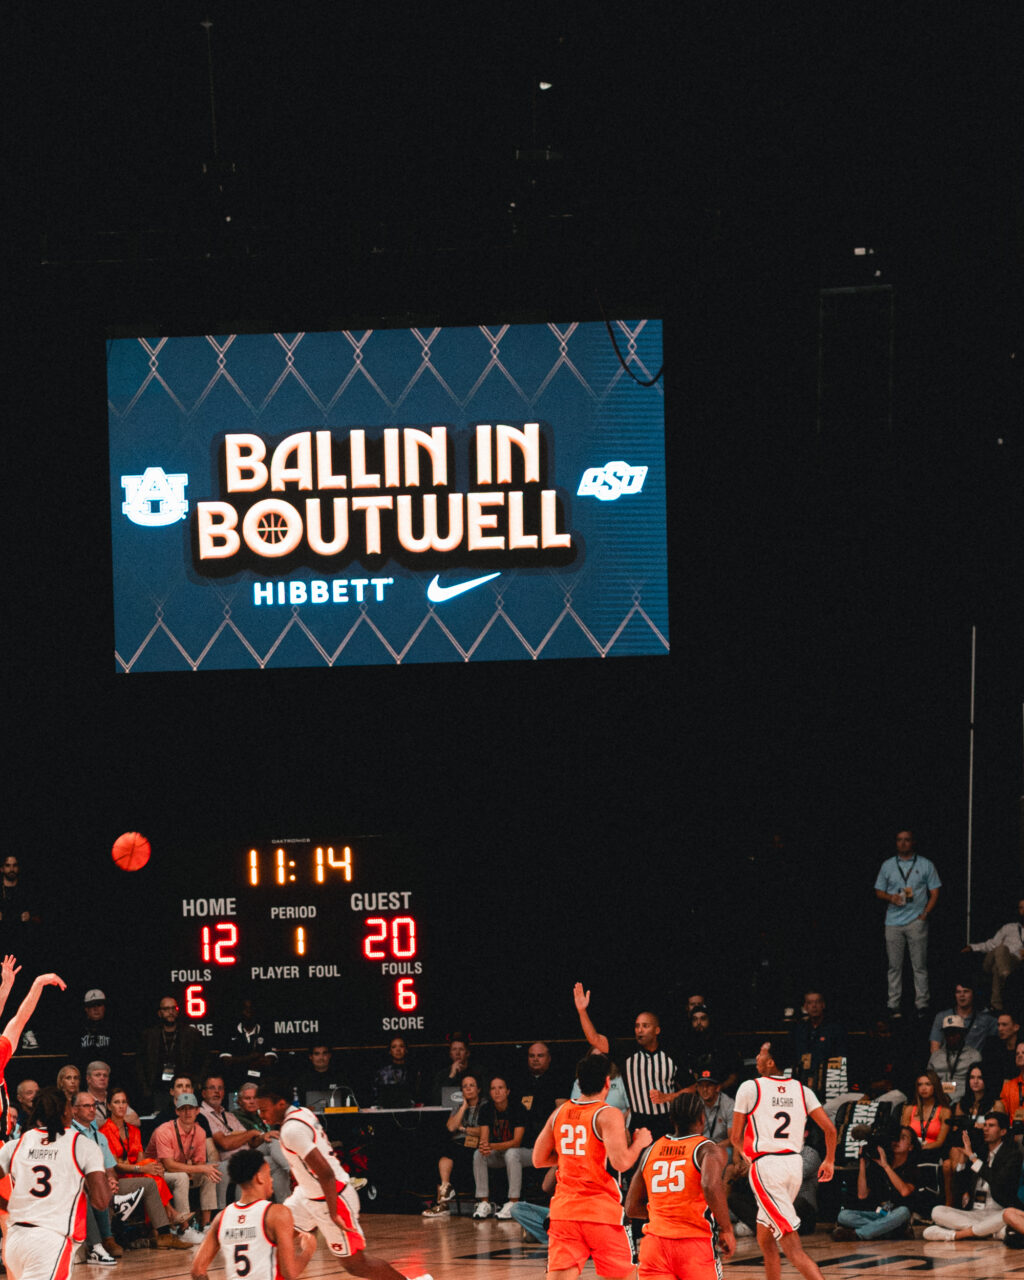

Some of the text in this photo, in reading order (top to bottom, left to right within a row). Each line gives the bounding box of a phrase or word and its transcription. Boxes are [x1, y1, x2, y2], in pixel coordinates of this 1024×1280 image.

[225, 422, 540, 493] BALLIN IN
[196, 489, 572, 560] BOUTWELL
[253, 577, 394, 605] HIBBETT
[248, 846, 353, 886] 11:14
[182, 897, 237, 917] HOME
[270, 905, 317, 919] PERIOD
[350, 891, 412, 912] GUEST
[201, 922, 238, 964] 12
[295, 926, 306, 956] 1
[363, 916, 416, 959] 20
[170, 968, 212, 983] FOULS
[251, 964, 341, 980] PLAYER FOUL
[381, 961, 423, 975] FOULS
[185, 985, 206, 1018] 6
[396, 978, 417, 1011] 6
[274, 1020, 319, 1034] MATCH
[382, 1016, 424, 1031] SCORE
[560, 1124, 588, 1156] 22
[773, 1111, 792, 1139] 2
[27, 1148, 59, 1160] MURPHY
[29, 1165, 52, 1198] 3
[651, 1159, 687, 1194] 25
[234, 1244, 251, 1278] 5
